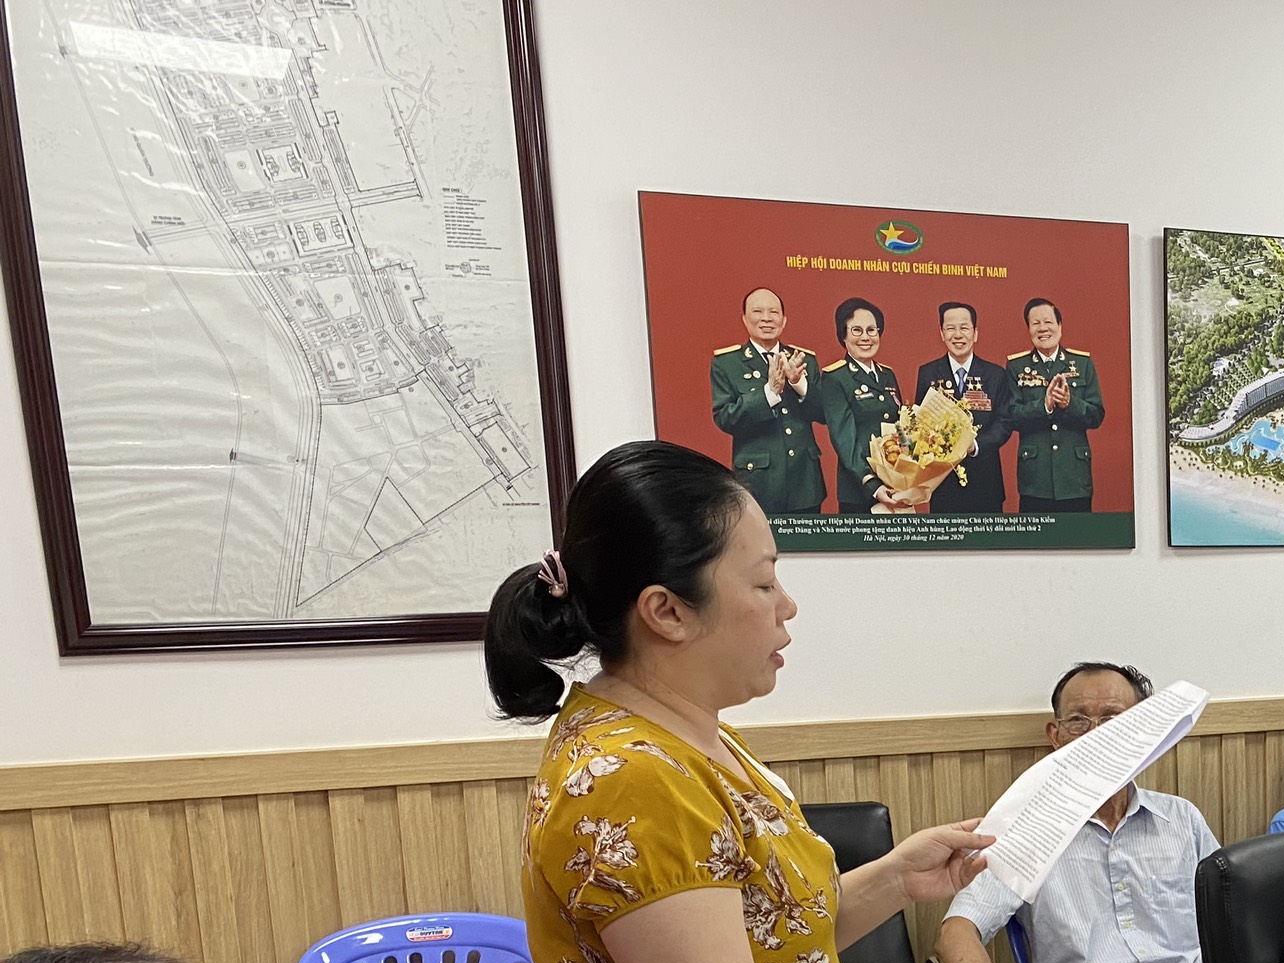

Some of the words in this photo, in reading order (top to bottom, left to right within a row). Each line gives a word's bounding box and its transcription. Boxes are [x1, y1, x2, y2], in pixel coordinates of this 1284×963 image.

[786, 254, 808, 271] HIỆP
[811, 255, 827, 272] HỘI
[829, 258, 861, 271] DOANH
[864, 258, 890, 272] NHÂN
[892, 261, 911, 275] CỰU
[913, 260, 940, 275] CHIẾN
[942, 263, 963, 276] BINH
[966, 263, 984, 279] VIỆT
[987, 266, 1007, 278] NAM
[892, 517, 907, 525] CCB
[950, 533, 965, 541] 2020
